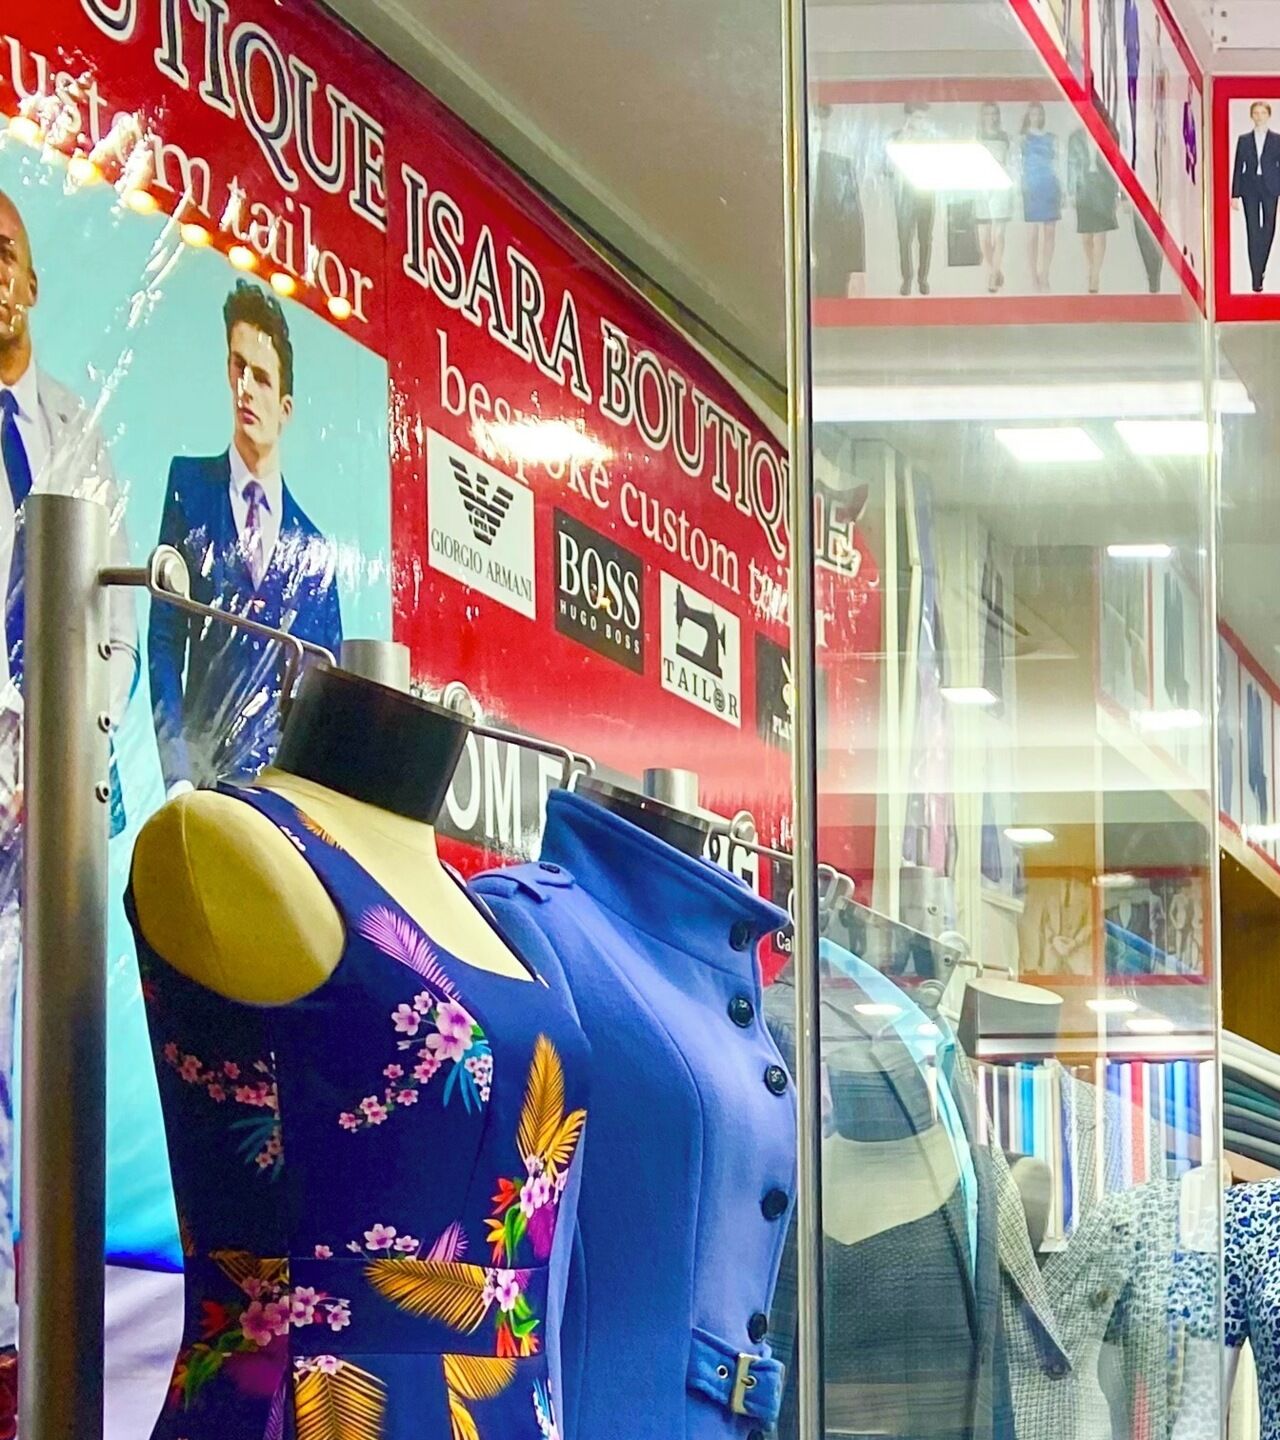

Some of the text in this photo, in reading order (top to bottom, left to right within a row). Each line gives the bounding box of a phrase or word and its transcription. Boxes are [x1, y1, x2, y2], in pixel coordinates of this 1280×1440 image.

[220, 175, 374, 323] tailor
[401, 162, 592, 405] ISARA
[431, 527, 533, 603] GIORGIO ARMANI
[558, 530, 641, 631] BOSS
[620, 481, 741, 595] custom
[559, 599, 641, 655] HUGO BOSS
[664, 657, 740, 719] TAILOR
